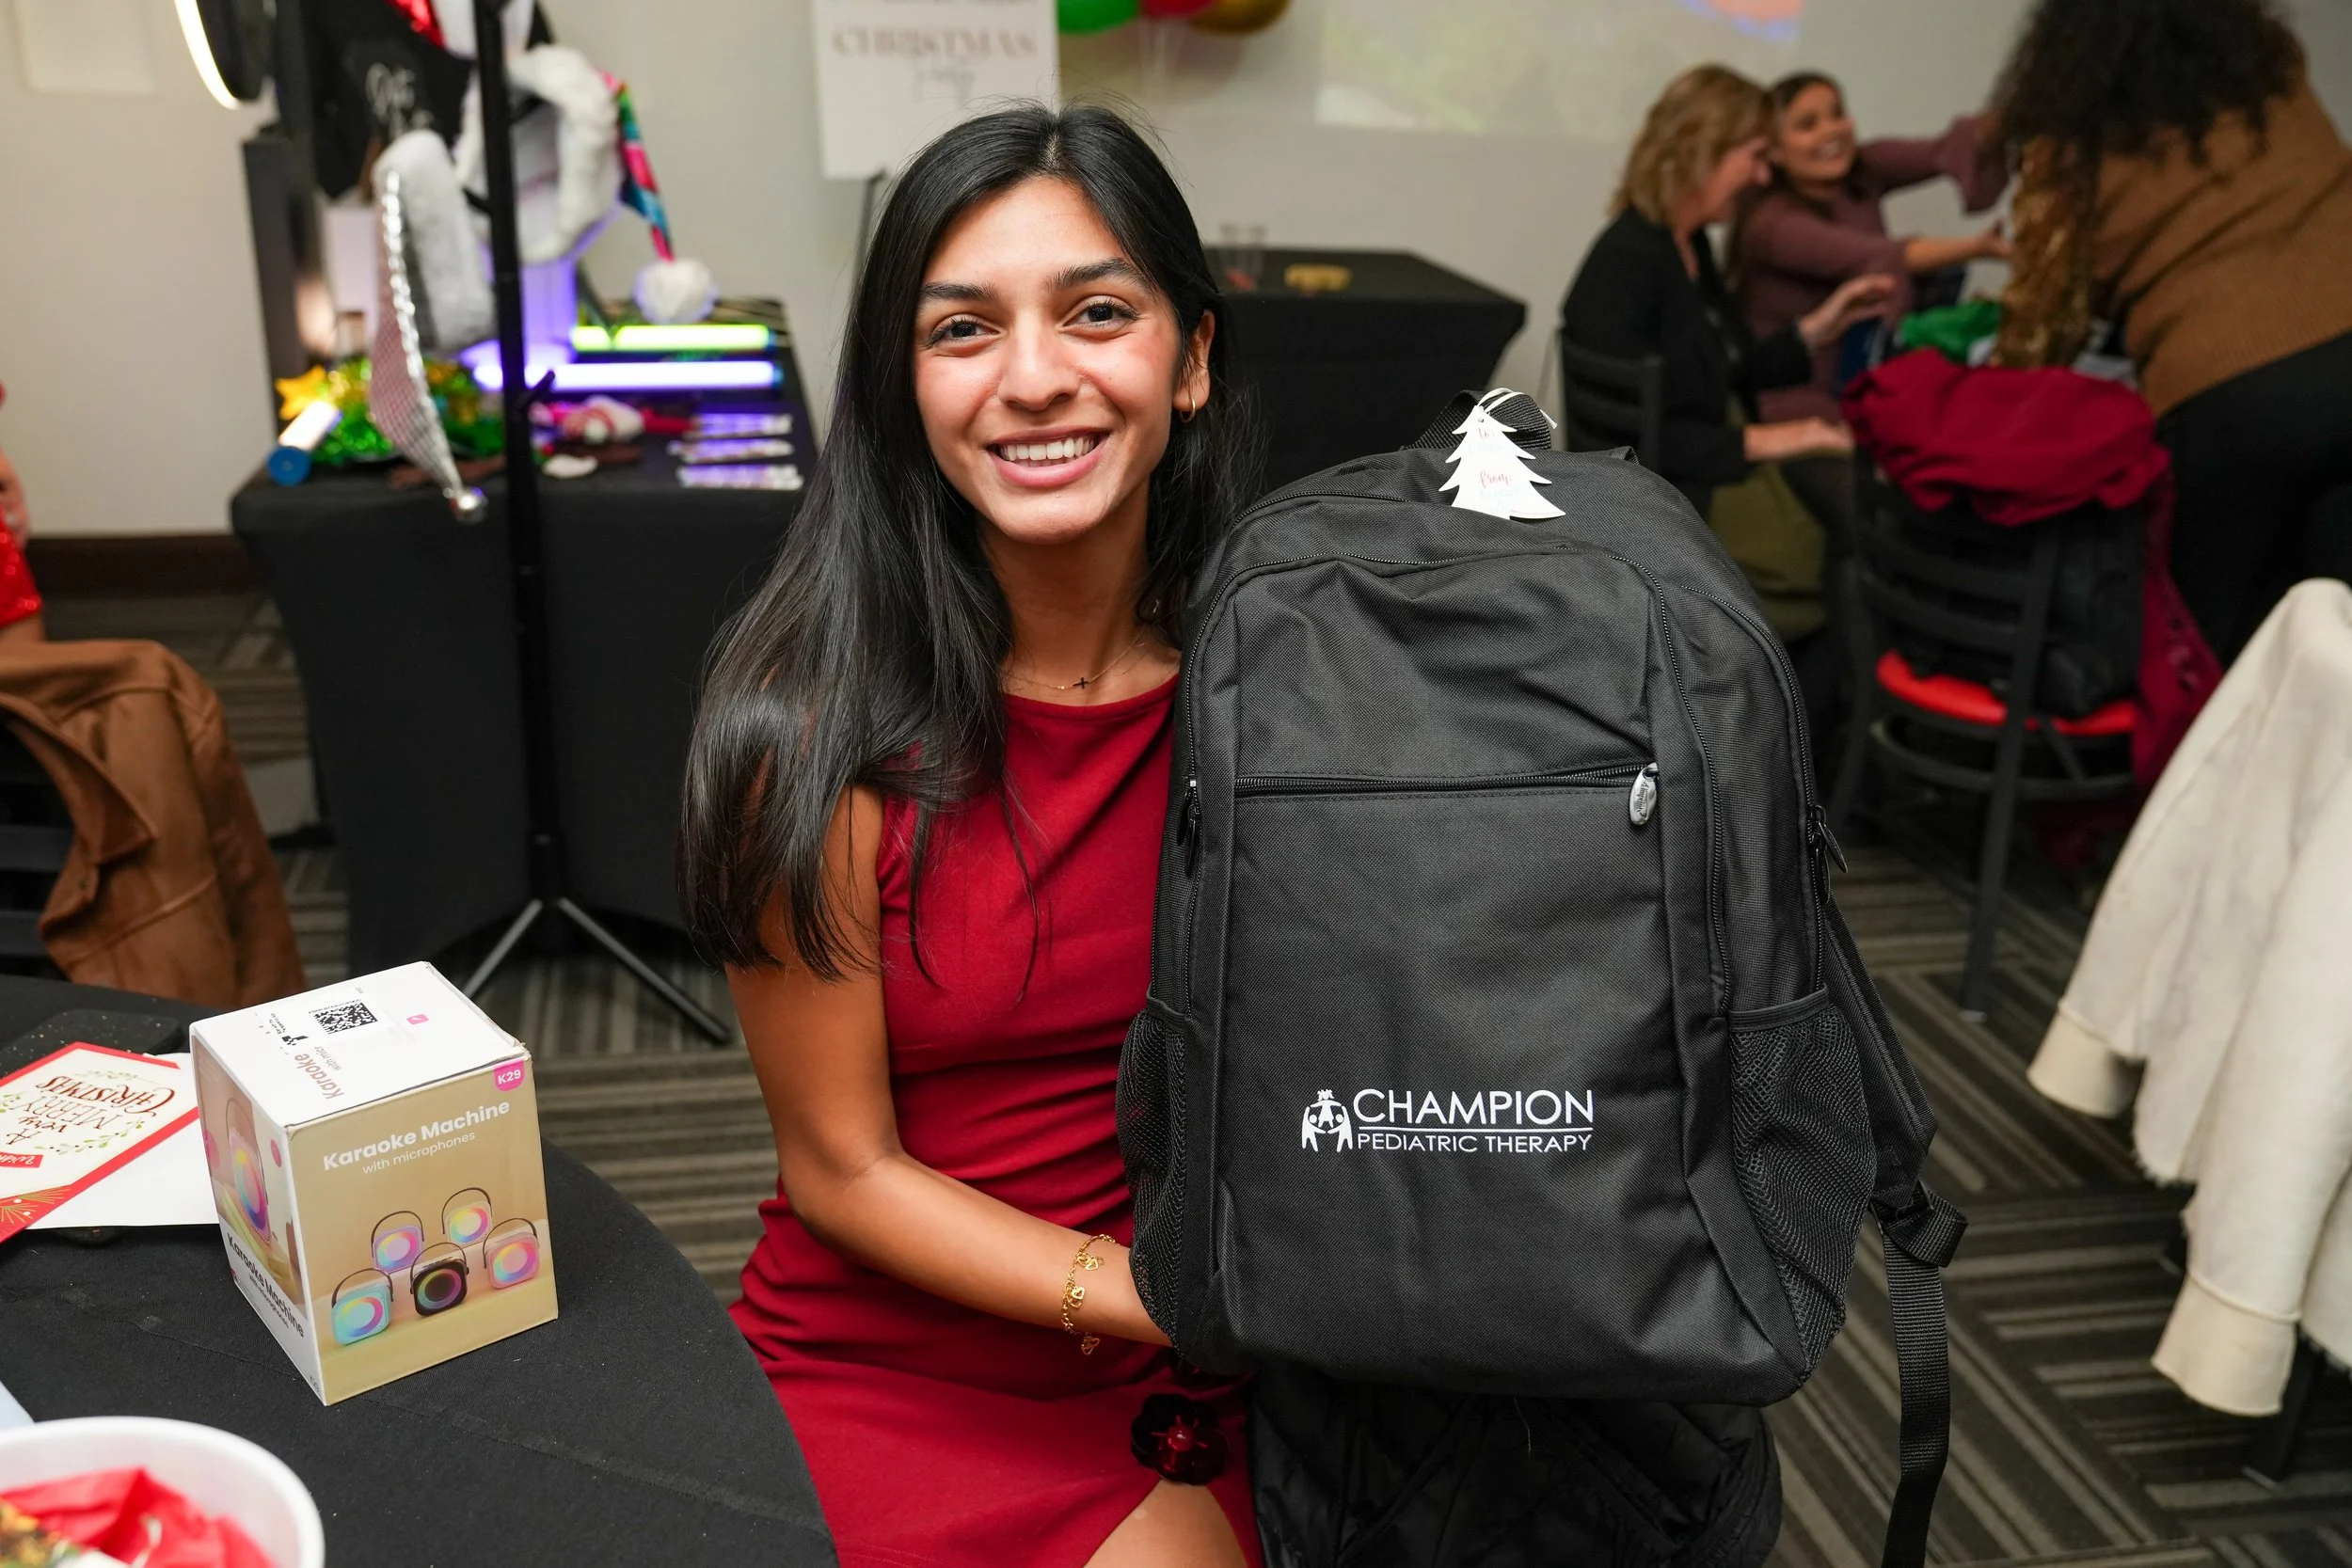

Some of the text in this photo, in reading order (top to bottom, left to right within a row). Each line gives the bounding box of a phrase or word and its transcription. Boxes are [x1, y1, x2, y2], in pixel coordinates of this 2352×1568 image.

[36, 1075, 175, 1117] CHRISTMAS
[294, 1053, 344, 1100] Karaoke
[498, 1069, 521, 1085] K29
[8, 1096, 122, 1130] MERRY
[1353, 1088, 1594, 1125] CHAMPION
[6, 1129, 41, 1146] A
[322, 1101, 511, 1171] Karaoke Machine
[361, 1131, 476, 1175] with microphones
[1358, 1132, 1593, 1153] PEDIATRIC THERAPY
[227, 1232, 264, 1287] Karaoke
[265, 1278, 304, 1338] Machine
